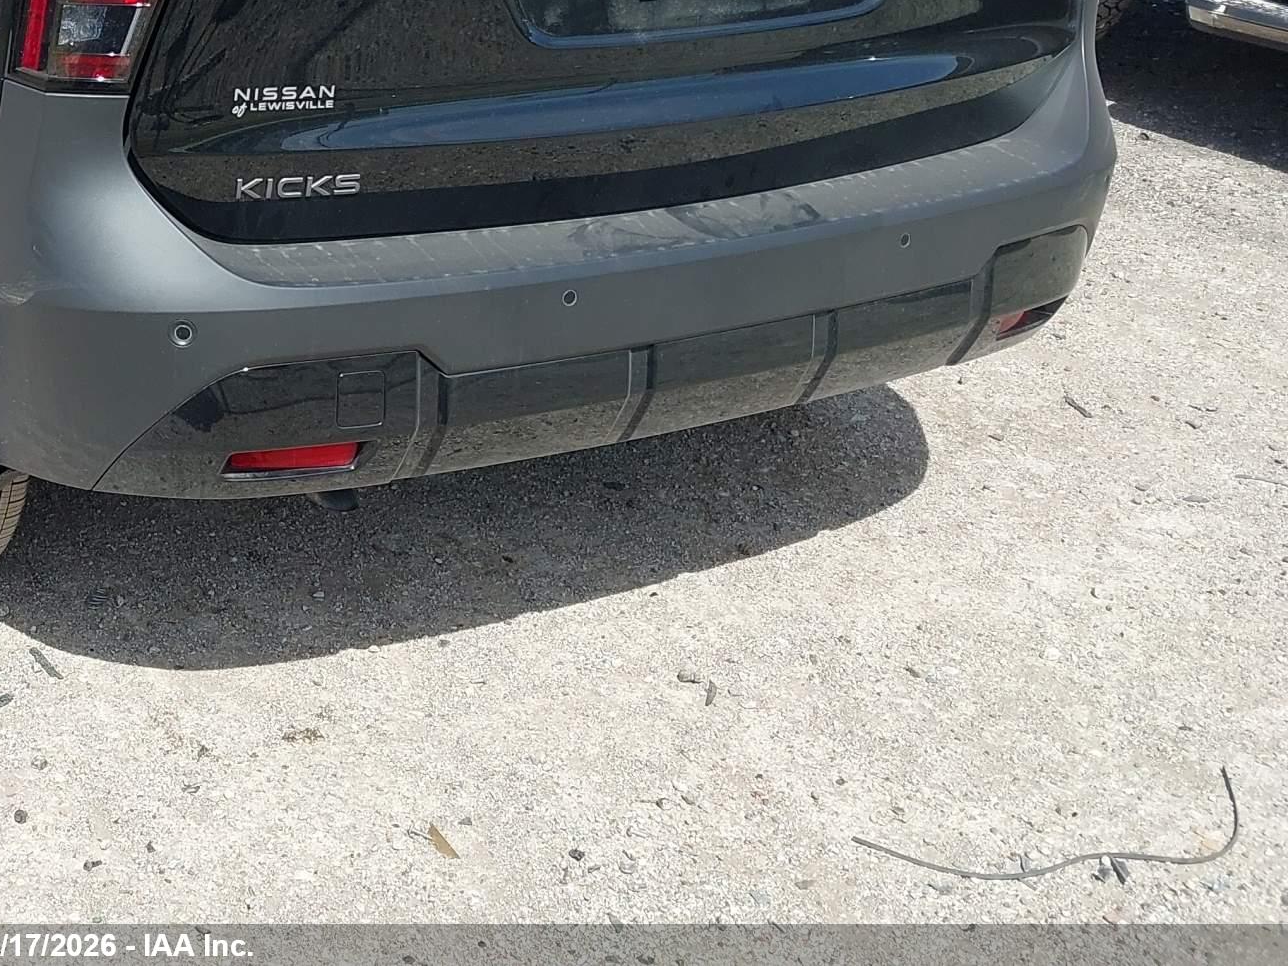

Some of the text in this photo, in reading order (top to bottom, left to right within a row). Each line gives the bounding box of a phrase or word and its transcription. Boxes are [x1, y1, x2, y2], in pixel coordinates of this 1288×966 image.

[233, 85, 336, 101] NISSAN
[231, 100, 334, 118] of LEWISVILLE
[235, 174, 361, 200] KICKS
